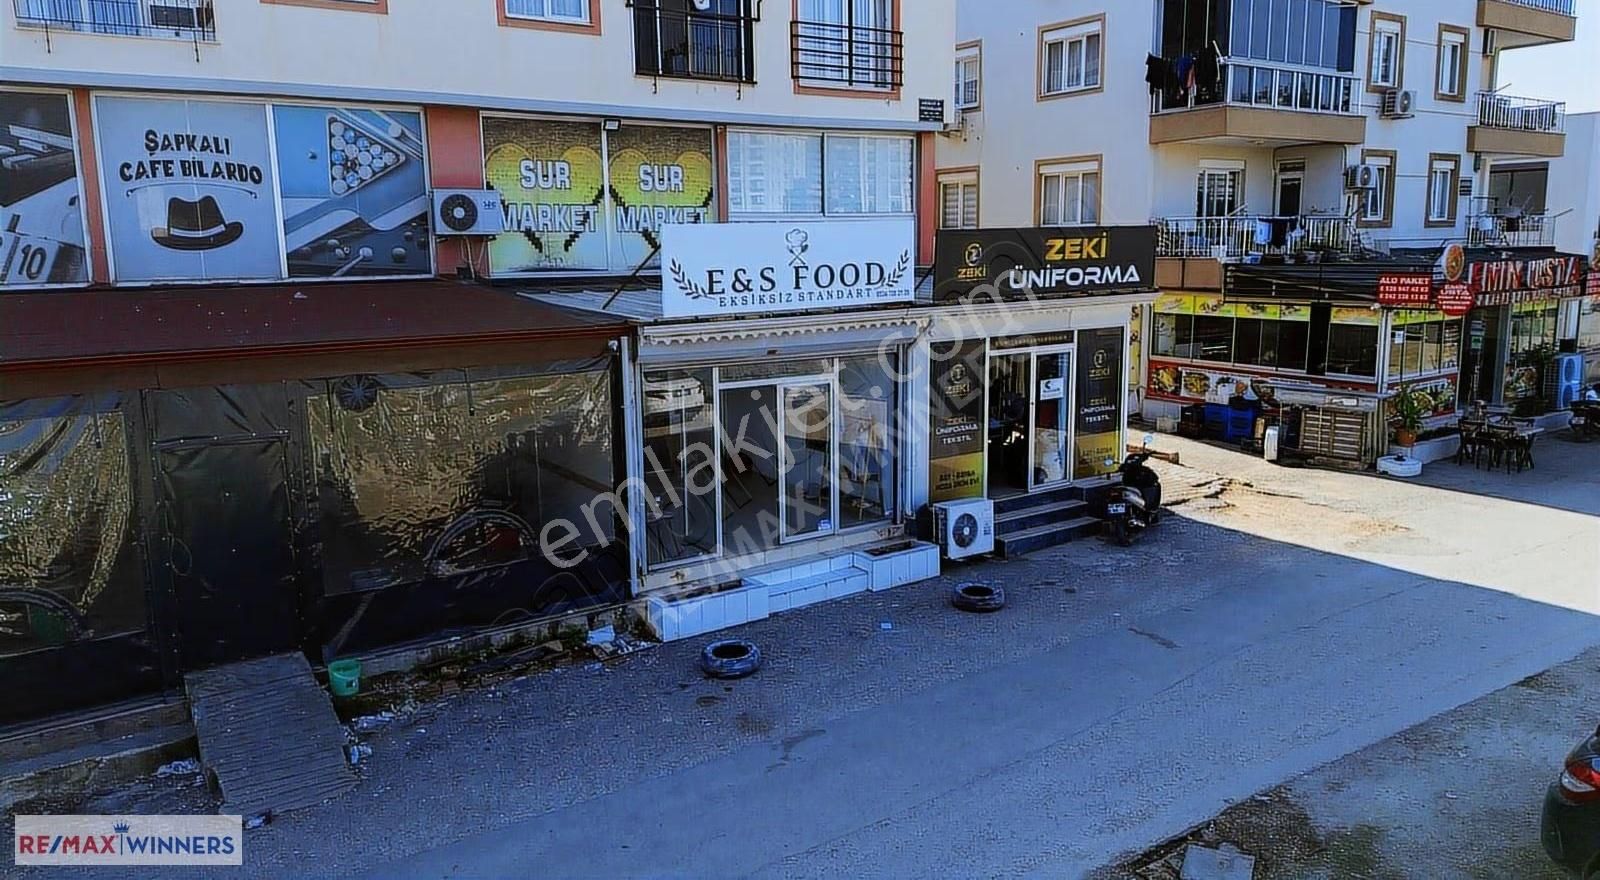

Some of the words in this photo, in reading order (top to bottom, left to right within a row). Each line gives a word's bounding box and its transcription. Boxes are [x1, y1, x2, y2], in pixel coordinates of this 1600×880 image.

[144, 129, 230, 157] ŞAPKALI
[119, 159, 175, 183] CAFE
[179, 156, 264, 186] BİLARDO
[519, 159, 572, 190] SUR
[638, 163, 685, 193] SUR
[500, 203, 600, 233] MARKET
[1044, 231, 1109, 262] ZEKİ
[706, 267, 777, 296] E&S
[793, 261, 886, 291] FOOD
[1009, 263, 1142, 290] ÜNİFORMA
[1400, 276, 1430, 286] PAKET
[798, 287, 873, 303] STANDART
